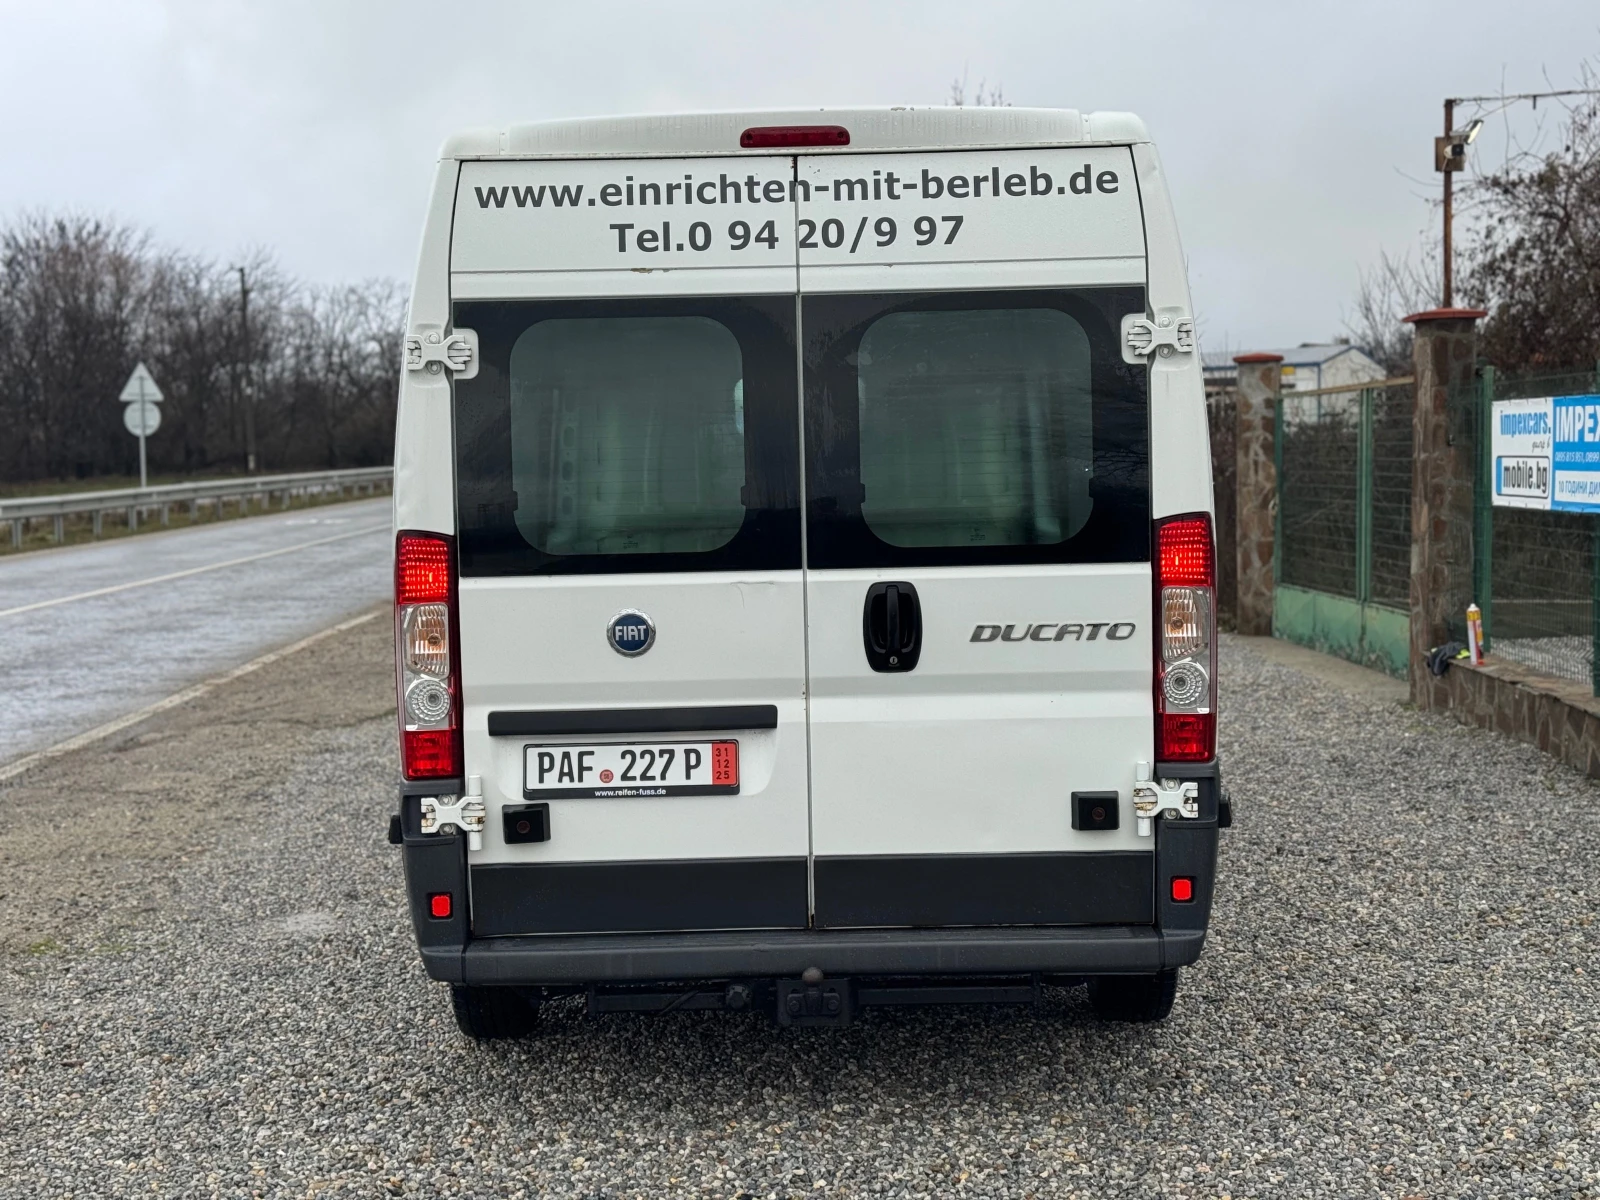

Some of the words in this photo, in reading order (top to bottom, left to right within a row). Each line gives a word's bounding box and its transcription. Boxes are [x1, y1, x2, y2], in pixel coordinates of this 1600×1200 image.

[473, 163, 1119, 209] www.einrichten-mit-berleb.de
[728, 220, 779, 251] 94
[798, 216, 897, 253] 20/9
[913, 215, 964, 246] 97
[1503, 460, 1547, 494] mobile.bg
[615, 625, 646, 641] FIAT
[969, 622, 1136, 642] DUCATO
[715, 747, 729, 757] 31
[537, 750, 595, 784] PAF
[620, 748, 676, 782] 227
[683, 748, 702, 781] P
[716, 759, 730, 769] 12
[715, 770, 730, 780] 25
[594, 788, 667, 797] www.reifen-fuss.de
